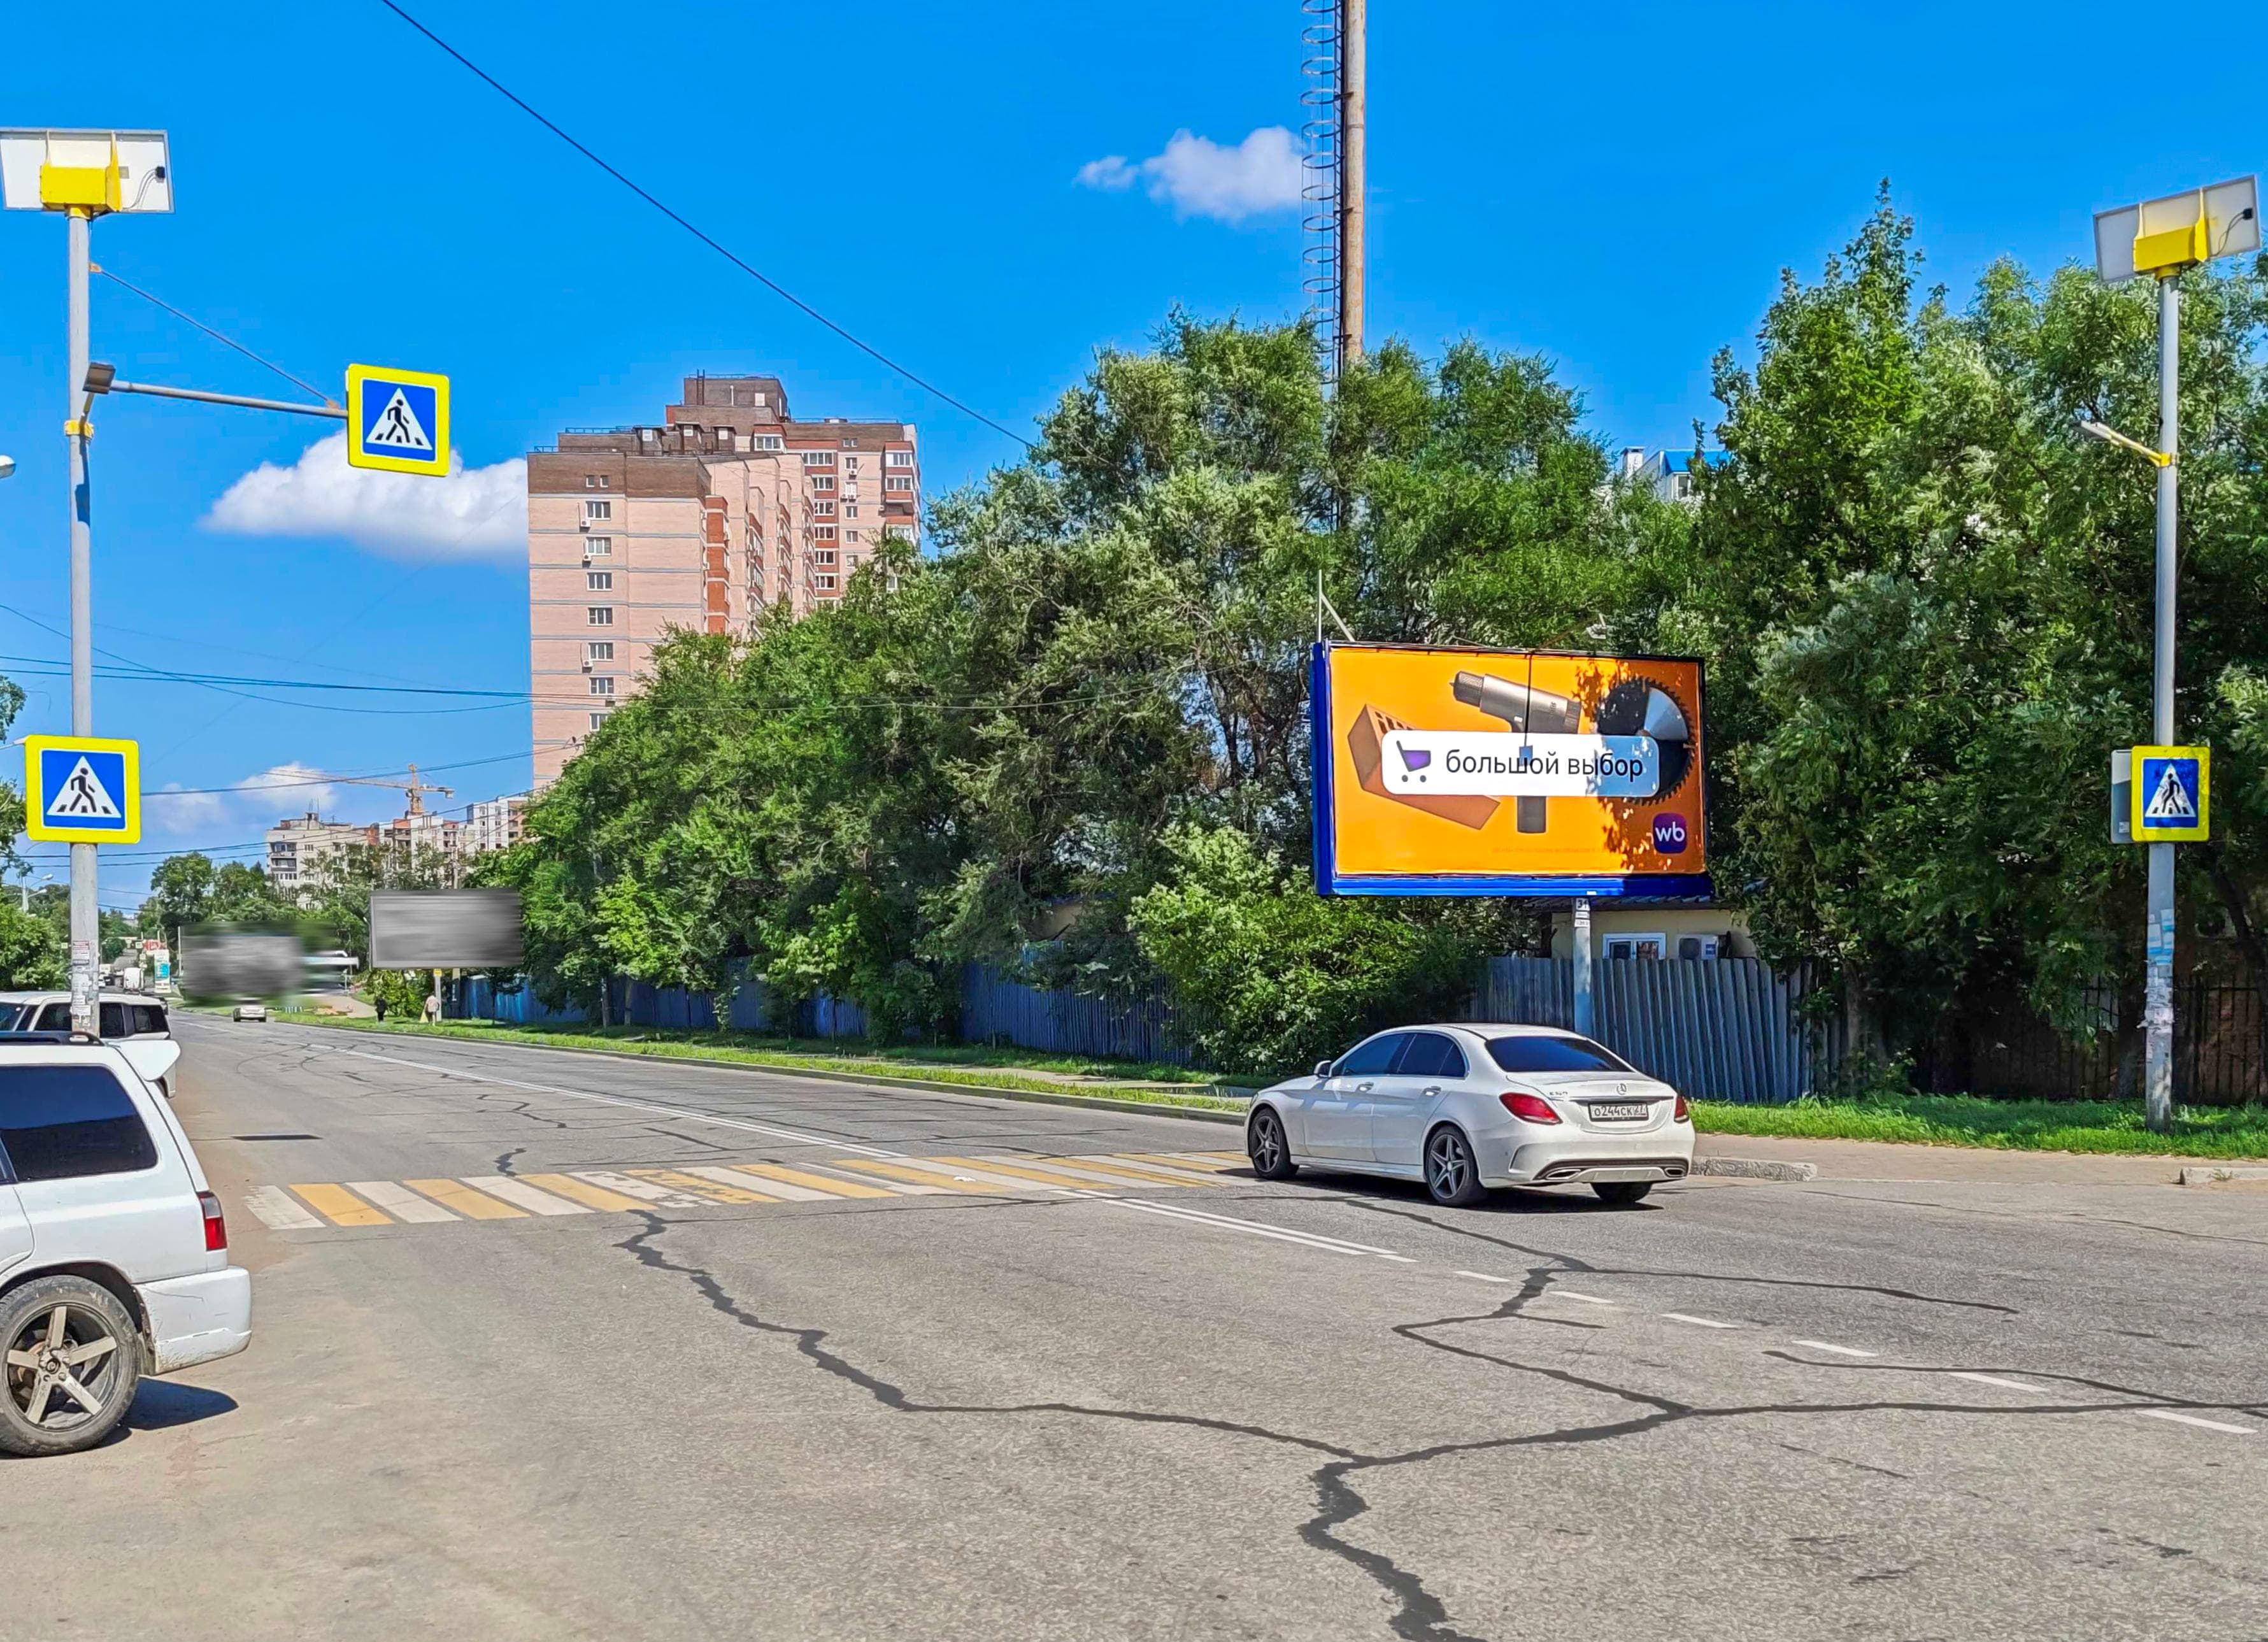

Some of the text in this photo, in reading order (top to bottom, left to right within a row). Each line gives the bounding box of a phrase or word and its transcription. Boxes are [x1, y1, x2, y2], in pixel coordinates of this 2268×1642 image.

[1446, 749, 1643, 782] большой выбор
[1655, 821, 1685, 841] wb
